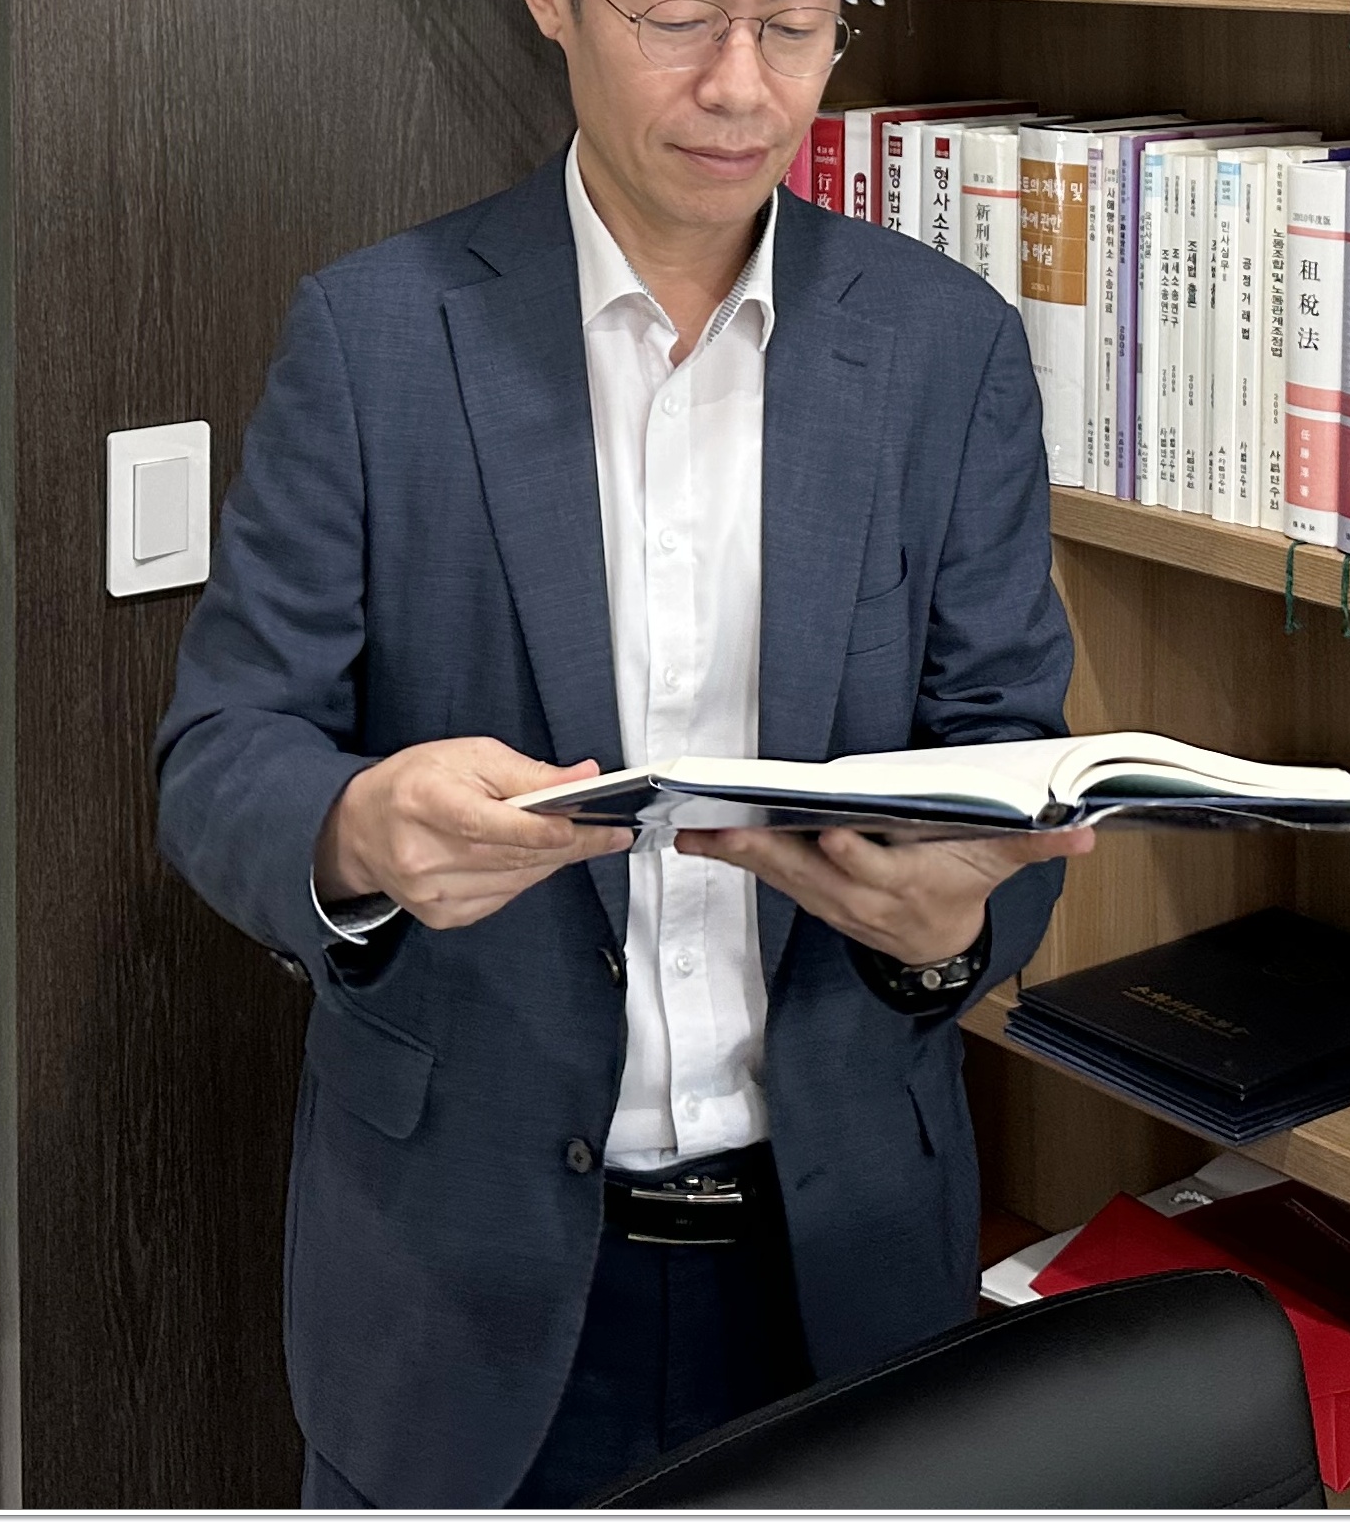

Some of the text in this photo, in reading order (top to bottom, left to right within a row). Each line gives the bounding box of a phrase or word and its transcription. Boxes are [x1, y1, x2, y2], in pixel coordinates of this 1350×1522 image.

[1070, 182, 1083, 202] 및
[1032, 243, 1053, 266] 해설
[1171, 248, 1180, 328] 조세소송연구
[1298, 259, 1320, 351] 租稅法
